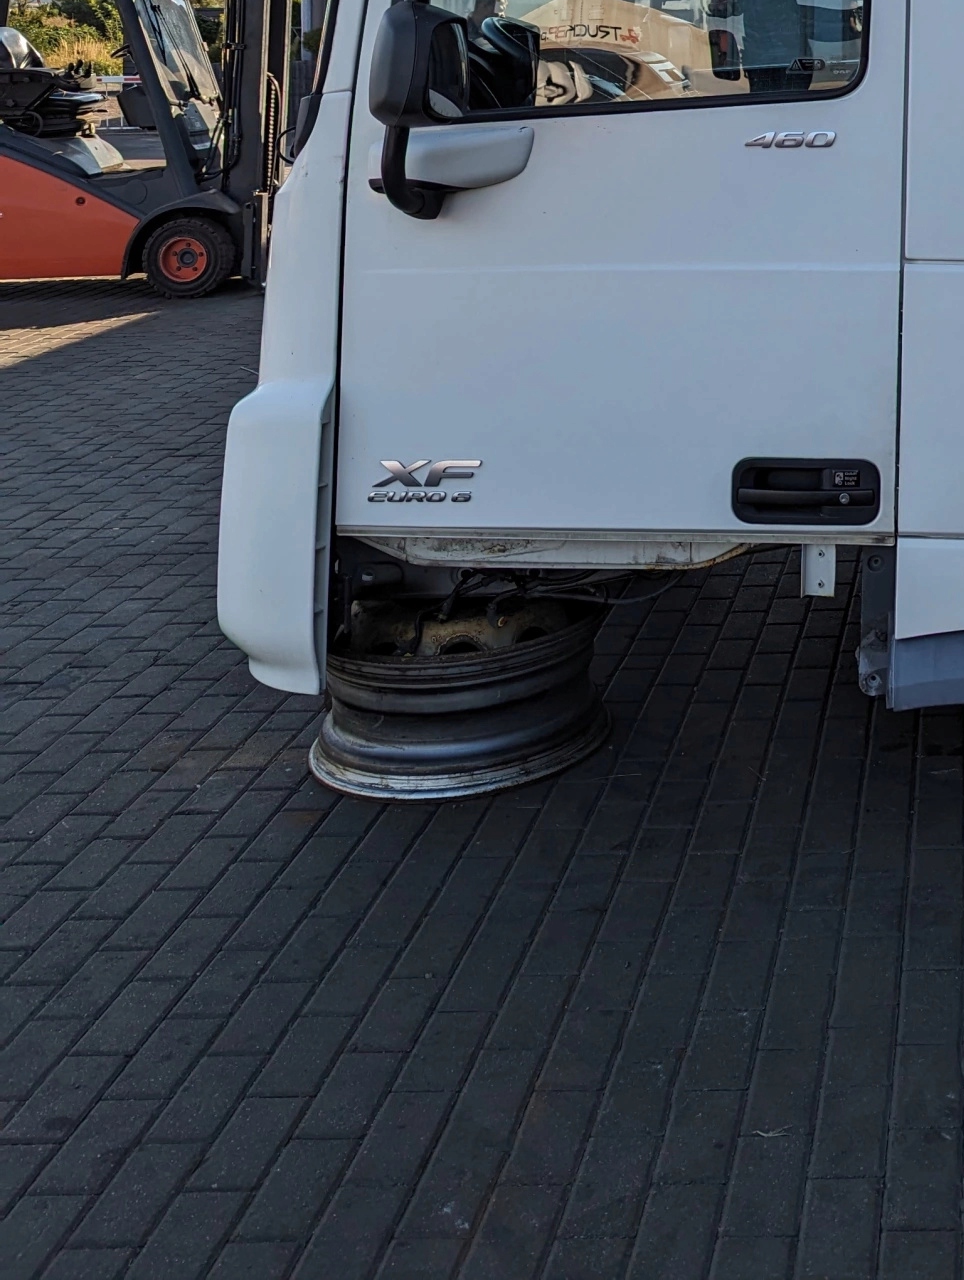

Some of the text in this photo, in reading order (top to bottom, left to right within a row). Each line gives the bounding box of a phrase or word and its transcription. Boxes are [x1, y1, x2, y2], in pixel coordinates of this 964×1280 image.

[744, 131, 837, 148] 460
[371, 459, 483, 487] XF
[367, 490, 472, 503] EURO 6
